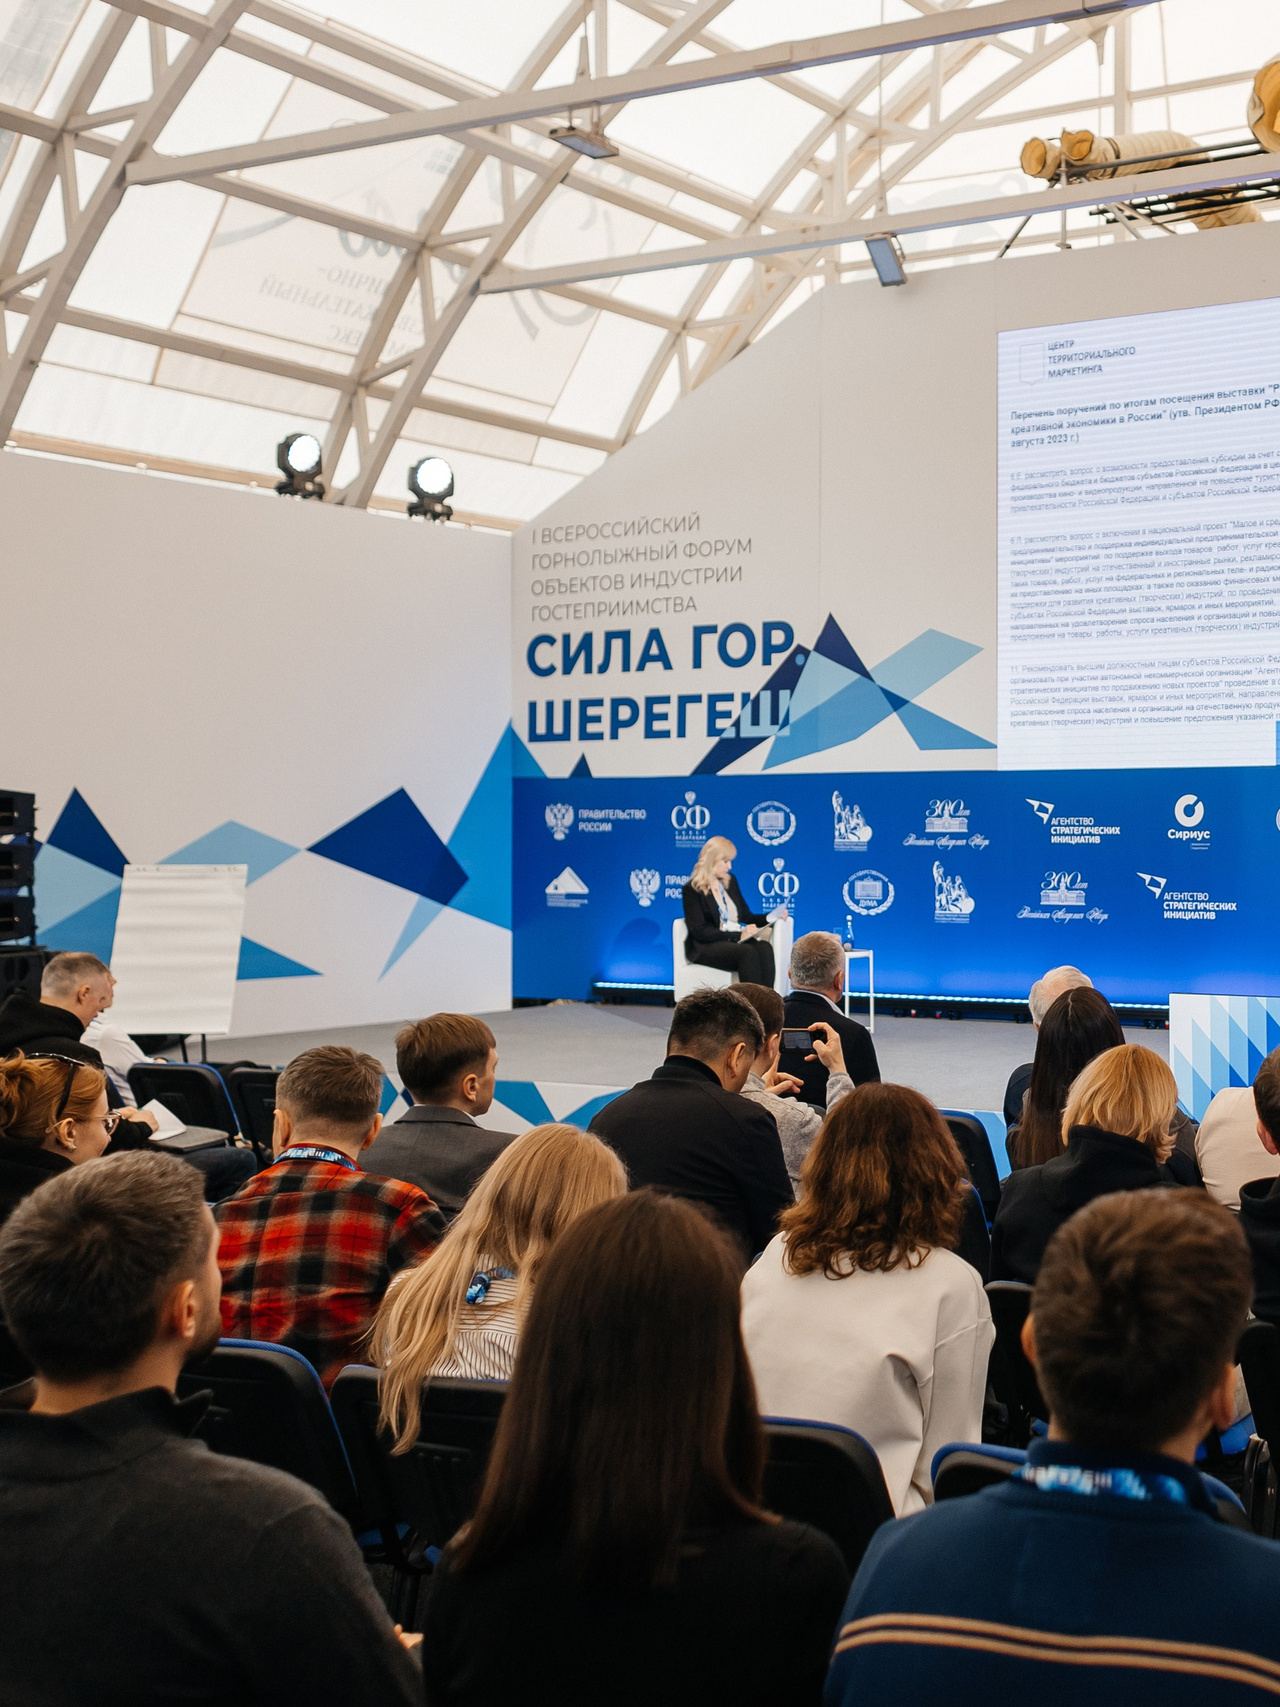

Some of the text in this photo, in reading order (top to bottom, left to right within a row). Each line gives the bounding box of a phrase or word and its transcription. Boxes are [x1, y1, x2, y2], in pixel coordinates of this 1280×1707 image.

[1048, 340, 1075, 351] ЦЕНТР
[1048, 346, 1136, 364] ТЕРРИТОРИАЛЬНОГО
[1048, 365, 1103, 378] МАРКЕТИНГА
[1011, 410, 1054, 421] Перечень
[1057, 404, 1106, 416] поручений
[1124, 398, 1156, 408] итогам
[1160, 391, 1214, 404] посещения
[1217, 387, 1265, 399] выставки
[1011, 420, 1063, 435] креативной
[1066, 416, 1116, 428] экономики
[1127, 410, 1167, 421] России"
[1170, 409, 1191, 420] (утв.
[1195, 402, 1261, 417] Президентом
[1264, 399, 1280, 408] РФ
[1011, 436, 1044, 448] августа
[1047, 434, 1068, 444] 2023
[541, 512, 700, 543] ВСЕРОССИЙСКИЙ
[532, 538, 751, 570] ГОРНОЛЫЖНЫЙ ФОРУМ
[531, 566, 742, 596] ОБЪЕКТОВ ИНДУСТРИИ
[531, 596, 697, 622] ГОСТЕПРИИМСТВА
[526, 627, 673, 677] СИЛА
[528, 689, 790, 743] ШЕРЕГЕШ
[579, 809, 646, 819] ПРАВИТЕЛЬСТВО
[671, 805, 710, 830] СФ
[579, 822, 612, 832] РОССИИ
[1051, 817, 1094, 826] АГЕНТСТВО
[1051, 826, 1120, 835] СТРАТЕГИЧЕСКИХ
[1168, 829, 1210, 841] Сириус
[1051, 836, 1100, 844] ИНИЦИАТИВ
[758, 872, 800, 897] СФ
[1163, 892, 1209, 901] АГЕНТСТВО
[1163, 901, 1237, 911] СТРАТЕГИЧЕСКИХ
[1163, 911, 1216, 920] ИНИЦИАТИВ
